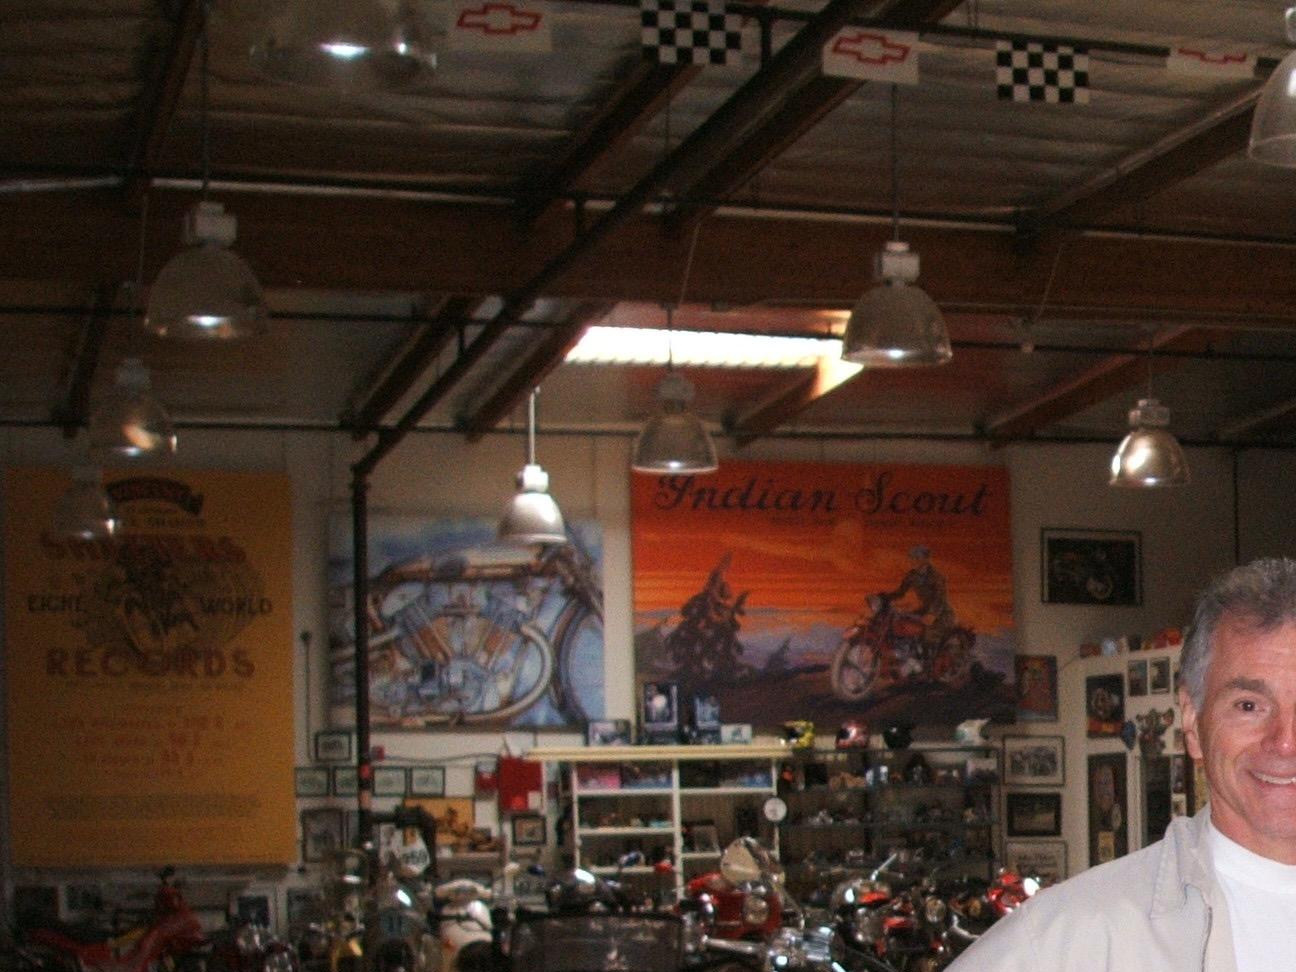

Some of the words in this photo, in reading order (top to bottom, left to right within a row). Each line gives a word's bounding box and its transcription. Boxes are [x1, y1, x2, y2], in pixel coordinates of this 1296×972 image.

[655, 473, 838, 512] Indian
[854, 471, 992, 516] Scout
[46, 647, 256, 678] RECORDS
